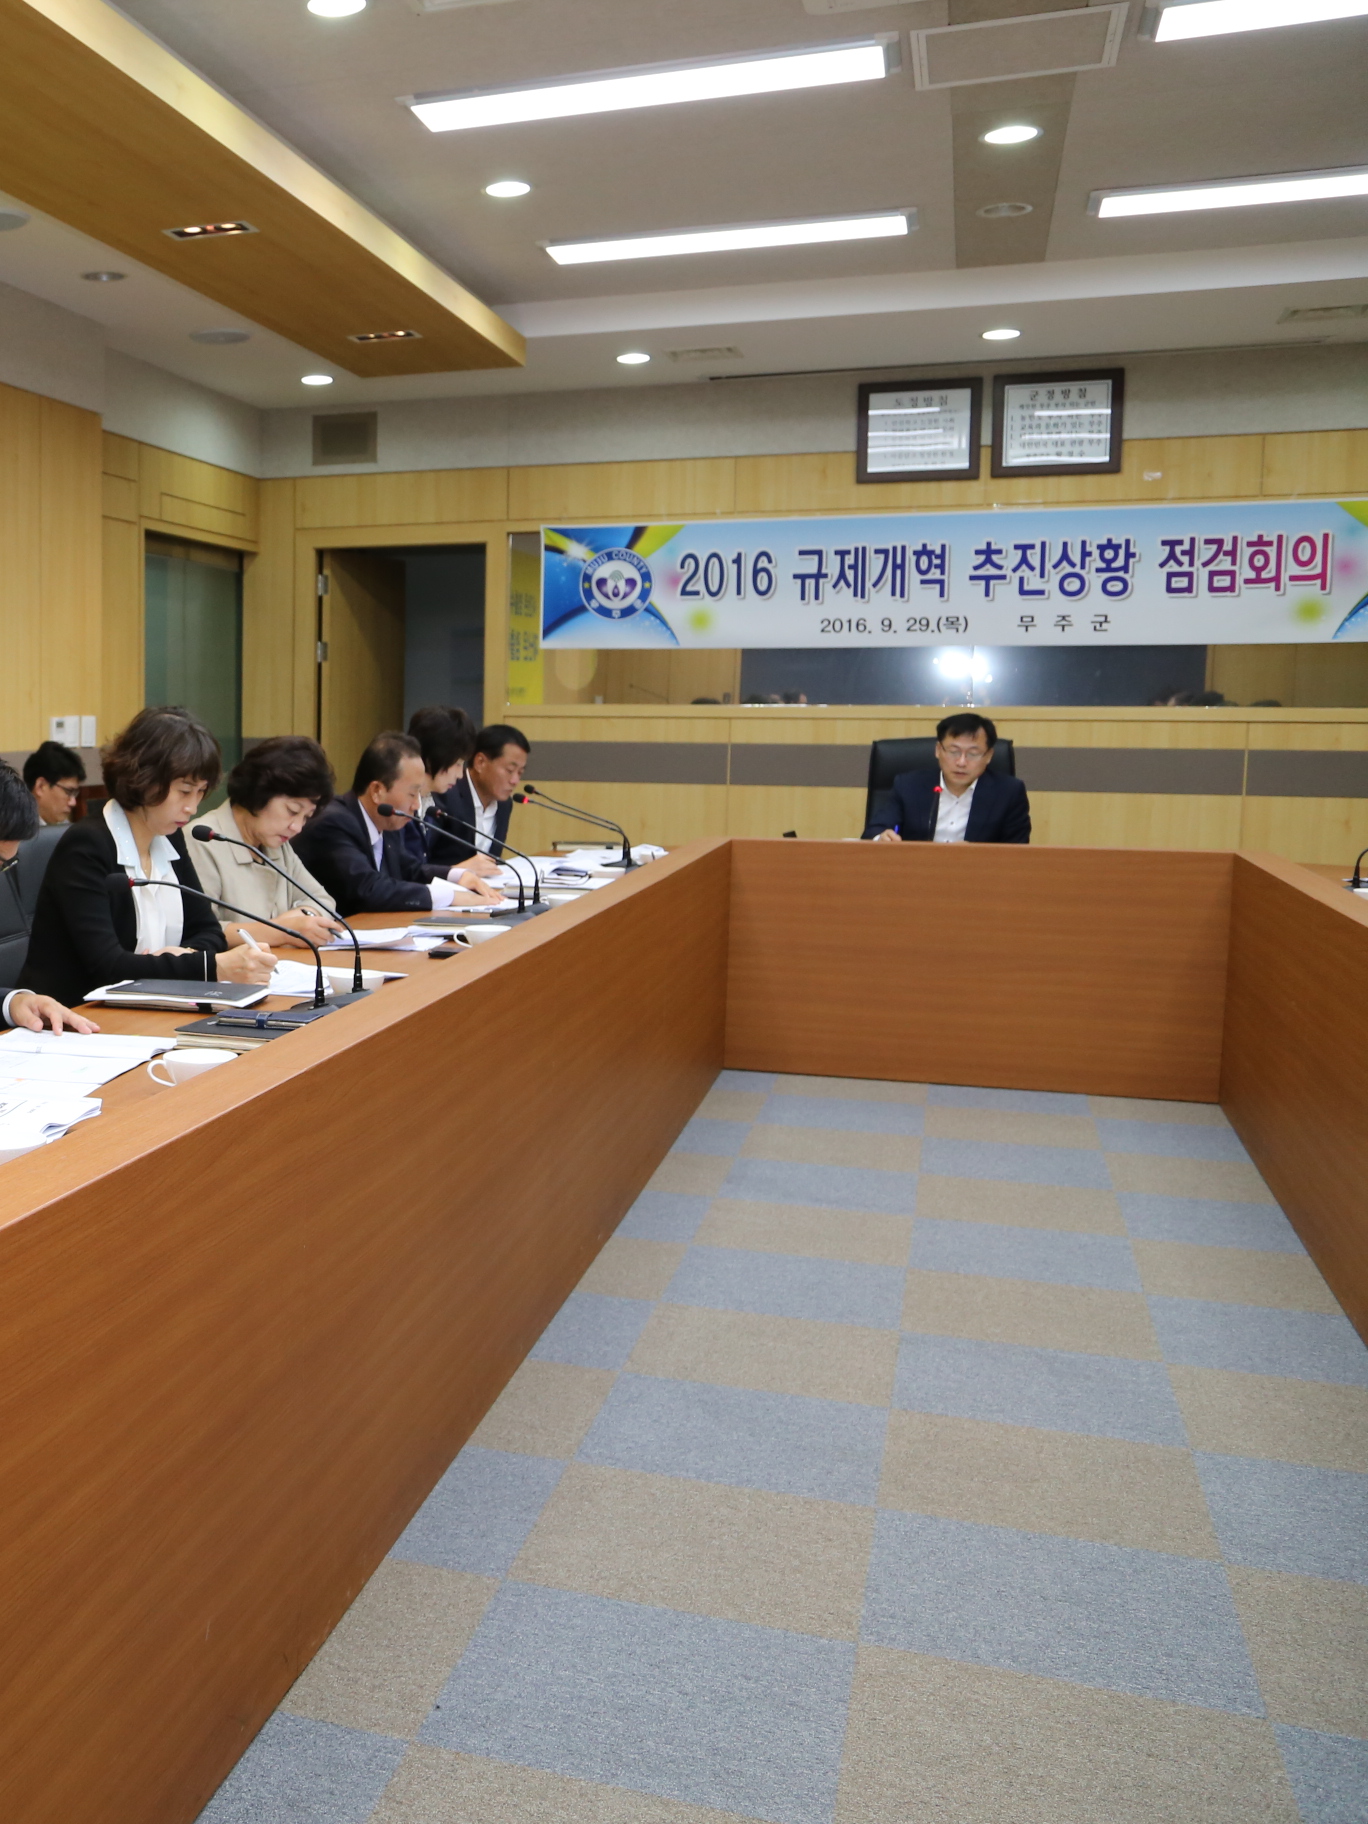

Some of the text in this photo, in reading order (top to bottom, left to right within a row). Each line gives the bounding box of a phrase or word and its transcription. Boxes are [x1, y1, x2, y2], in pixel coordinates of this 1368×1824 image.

[612, 550, 648, 573] COUNTY
[679, 531, 1330, 601] 2016 규제개혁 추진상황 점검회의
[820, 617, 872, 634] 2016.
[881, 617, 898, 634] 9.
[906, 615, 969, 634] 29.(목)
